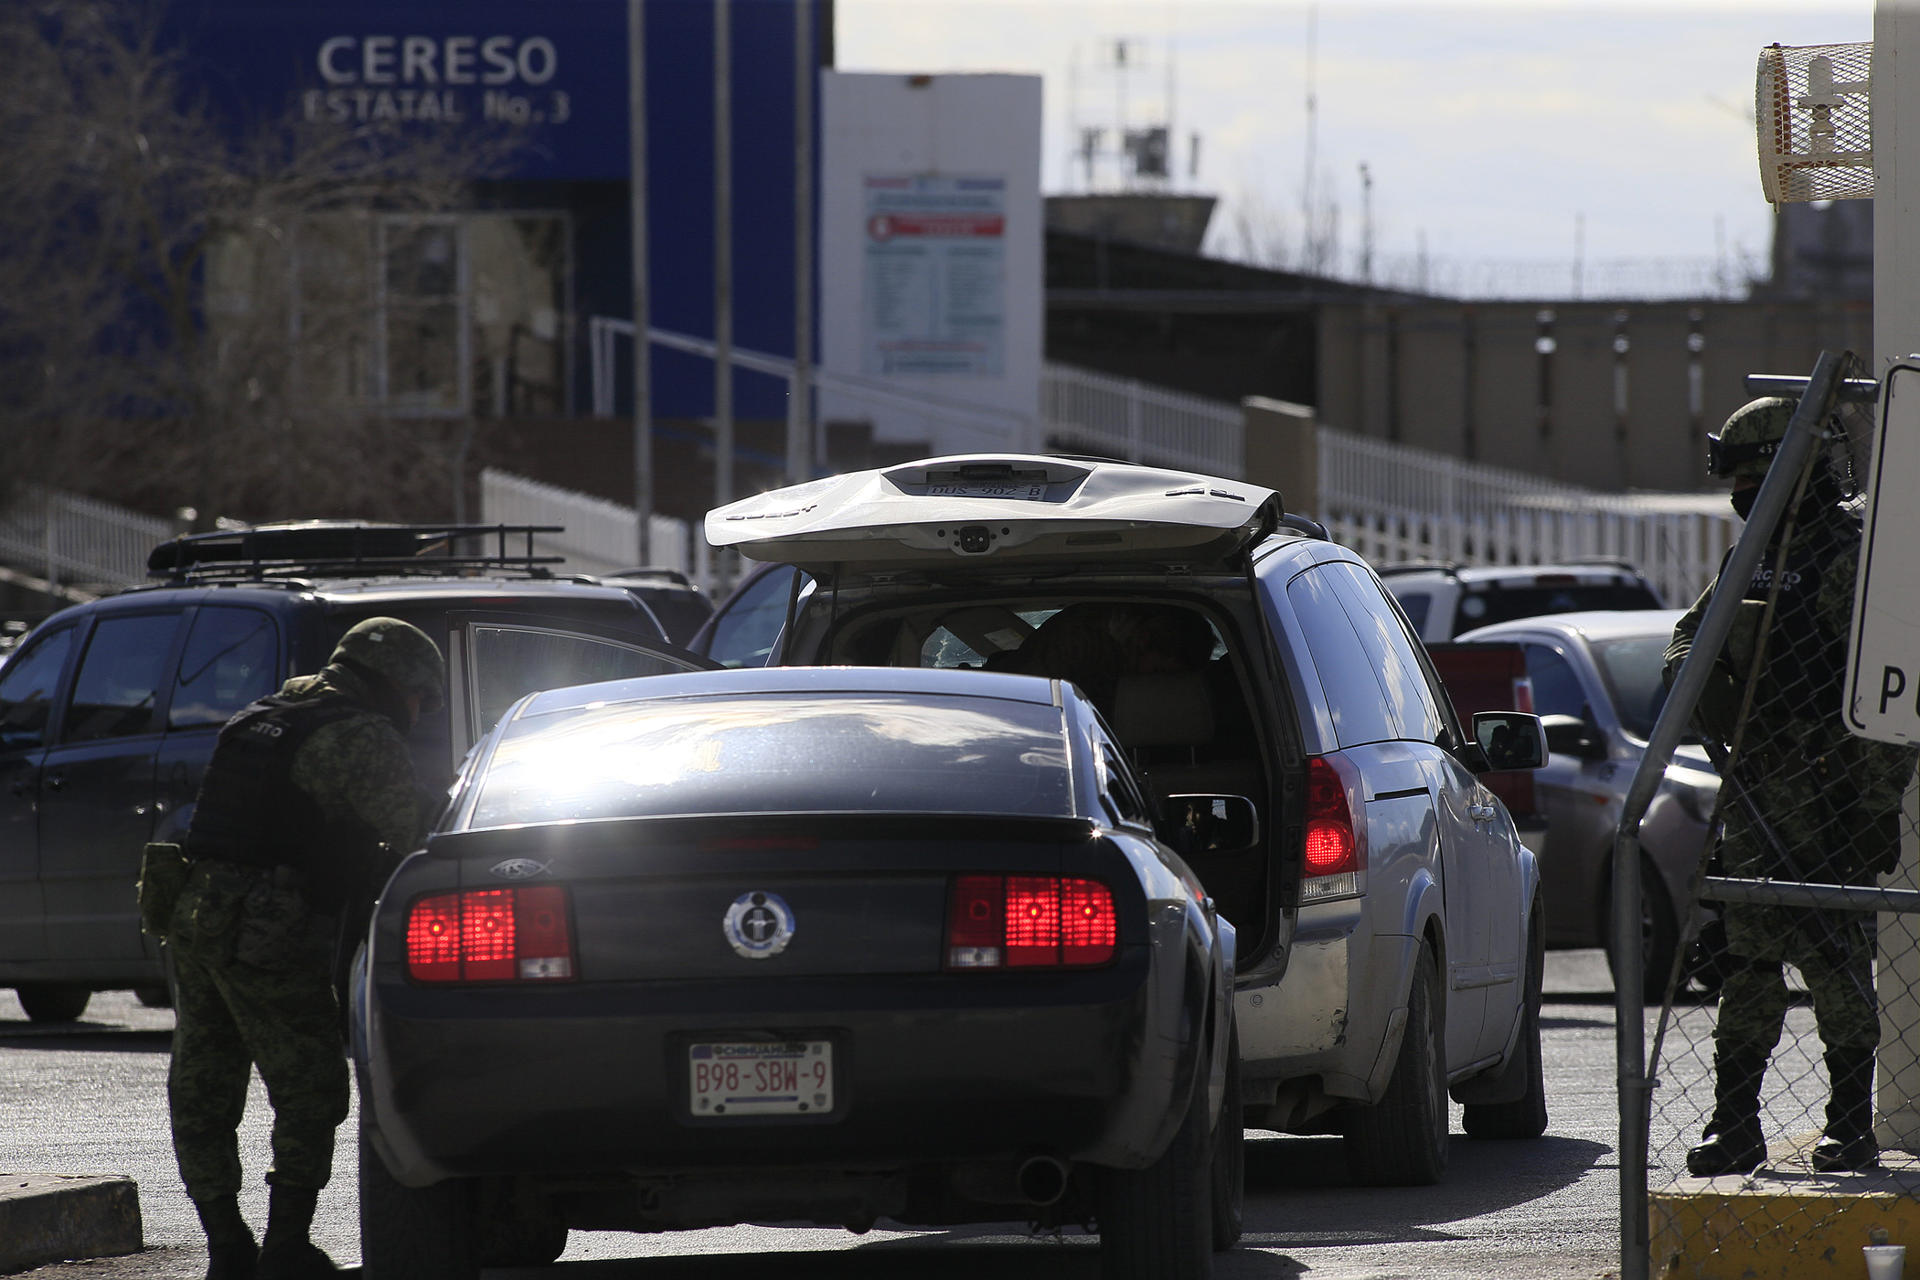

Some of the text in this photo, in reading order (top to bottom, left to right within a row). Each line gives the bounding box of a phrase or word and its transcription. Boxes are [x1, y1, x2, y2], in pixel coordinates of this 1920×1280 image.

[317, 35, 557, 85] CERESO
[303, 89, 466, 123] ESTATAL
[1880, 665, 1920, 719] P
[696, 1061, 827, 1094] B98-SBW-9
